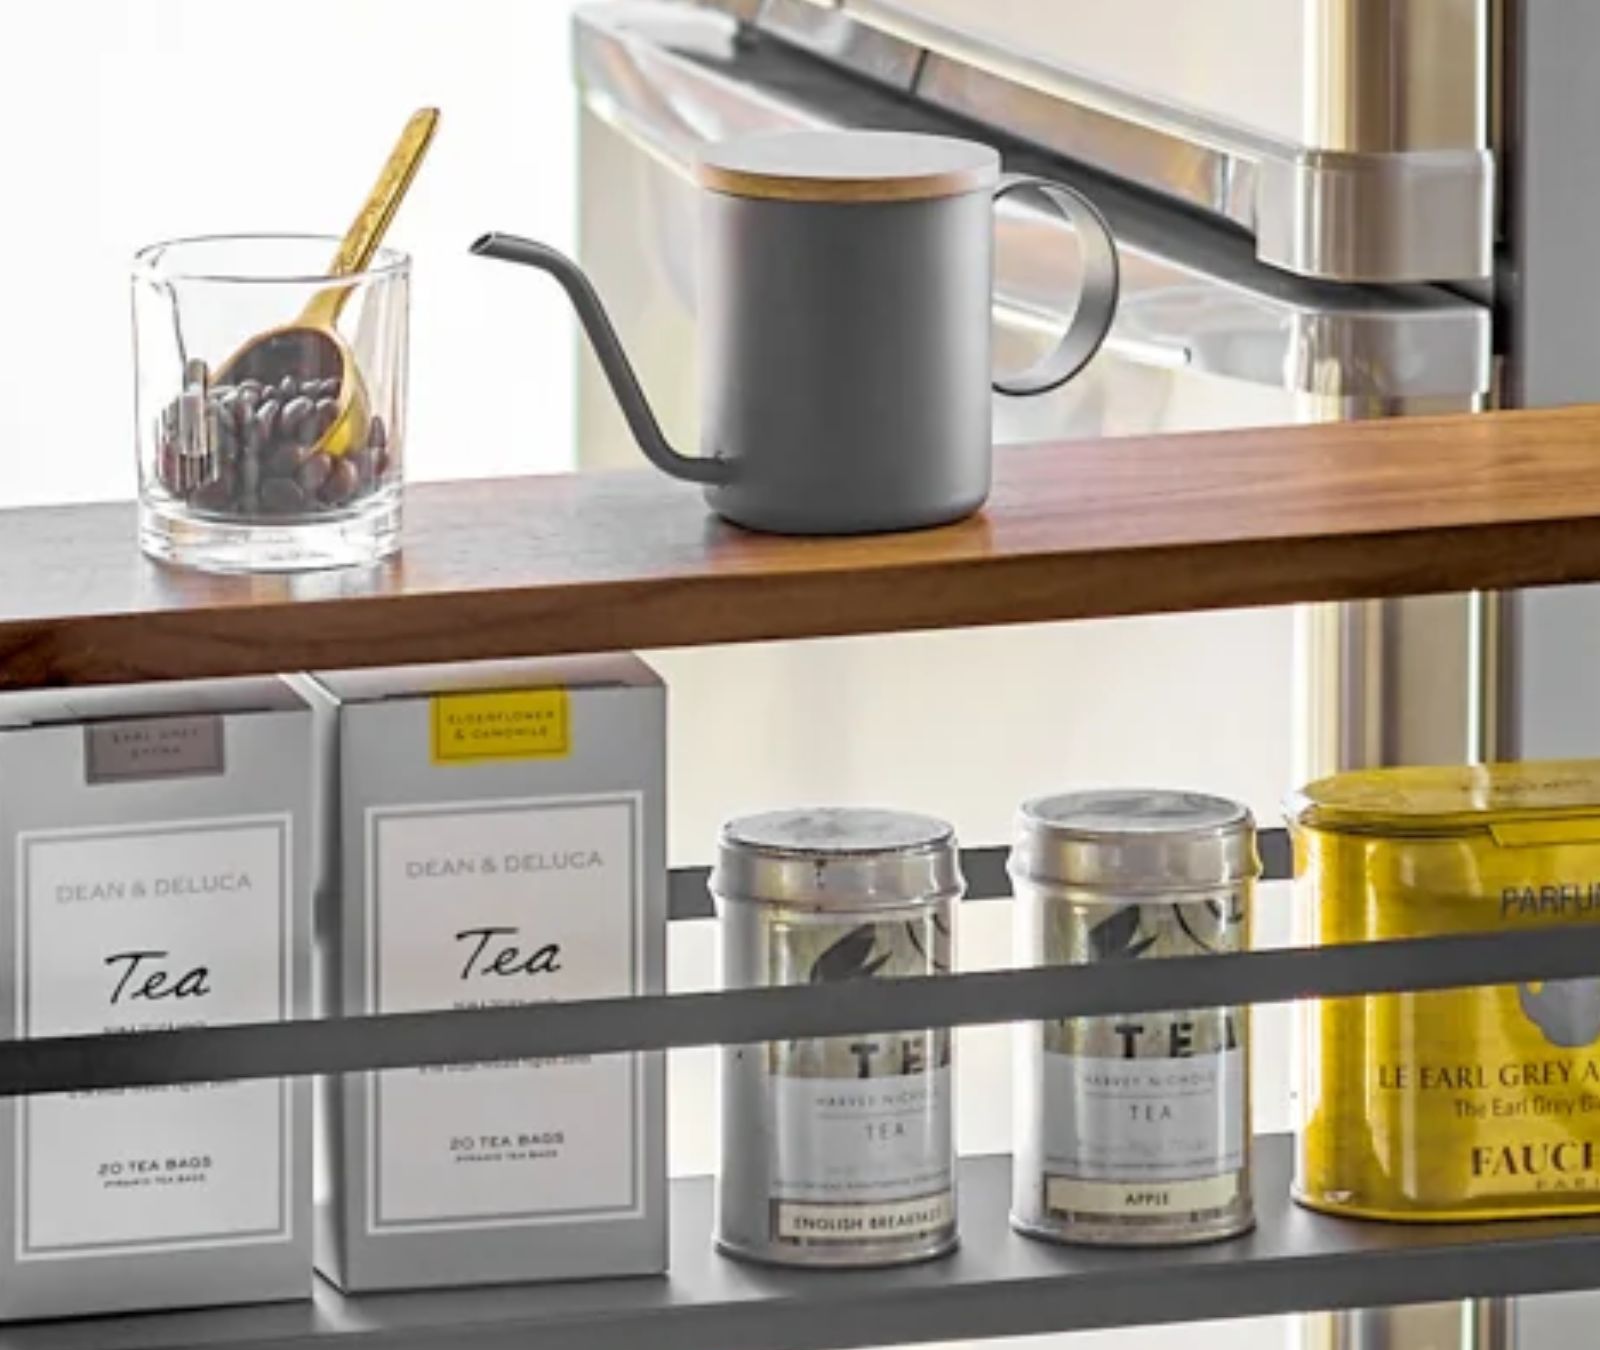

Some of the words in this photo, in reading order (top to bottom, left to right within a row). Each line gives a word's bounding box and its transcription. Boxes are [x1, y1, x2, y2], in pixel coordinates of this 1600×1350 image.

[405, 857, 476, 880] DEAN
[480, 856, 497, 875] &
[503, 850, 606, 875] DELUCA
[55, 879, 126, 903] DEAN
[131, 878, 147, 899] &
[153, 872, 253, 898] DELUCA
[455, 926, 561, 980] Tea
[103, 950, 211, 1005] Tea
[1379, 1066, 1409, 1090] LE
[1419, 1064, 1490, 1090] EARL
[1499, 1060, 1573, 1087] GREY
[1130, 1104, 1172, 1123] TEA
[1453, 1098, 1487, 1119] The
[1492, 1094, 1528, 1116] Earl
[1532, 1095, 1575, 1117] Grey
[449, 1136, 475, 1151] 20
[480, 1134, 513, 1149] TEA
[518, 1130, 565, 1148] BAGS
[865, 1122, 904, 1141] TEA
[97, 1162, 123, 1177] 20
[128, 1159, 160, 1173] TEA
[164, 1156, 212, 1171] BAGS
[793, 1215, 863, 1232] ENGLISH
